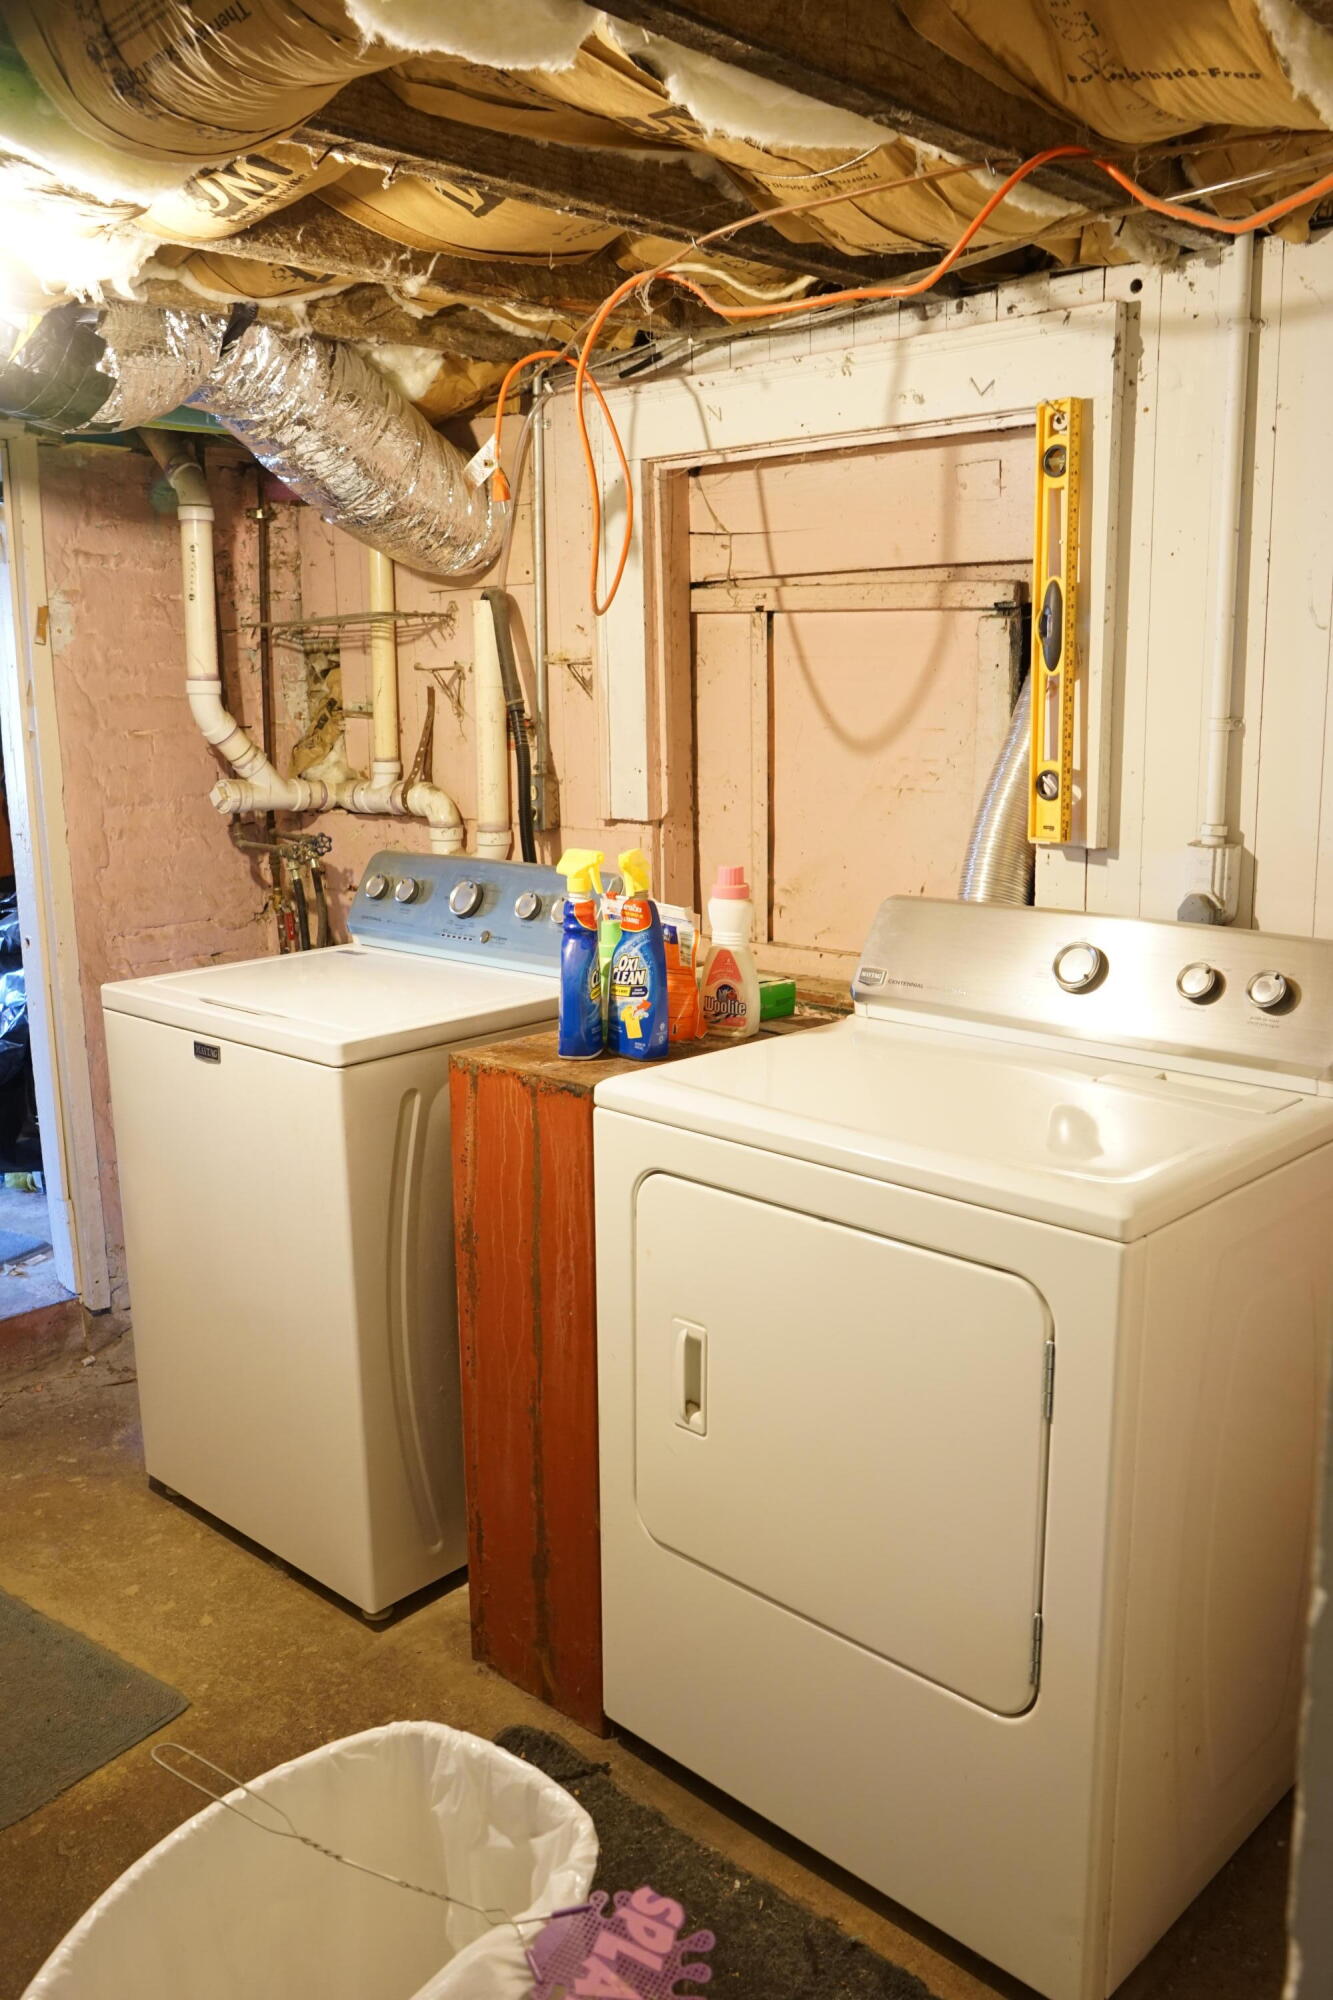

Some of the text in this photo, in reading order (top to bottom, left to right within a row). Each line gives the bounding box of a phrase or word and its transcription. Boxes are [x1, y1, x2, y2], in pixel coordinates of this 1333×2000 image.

[619, 955, 640, 972] OXI
[612, 967, 646, 985] CLEAN
[887, 978, 924, 989] CENTENNIAL
[704, 995, 747, 1015] Woolite
[565, 1886, 685, 2000] SPLA
